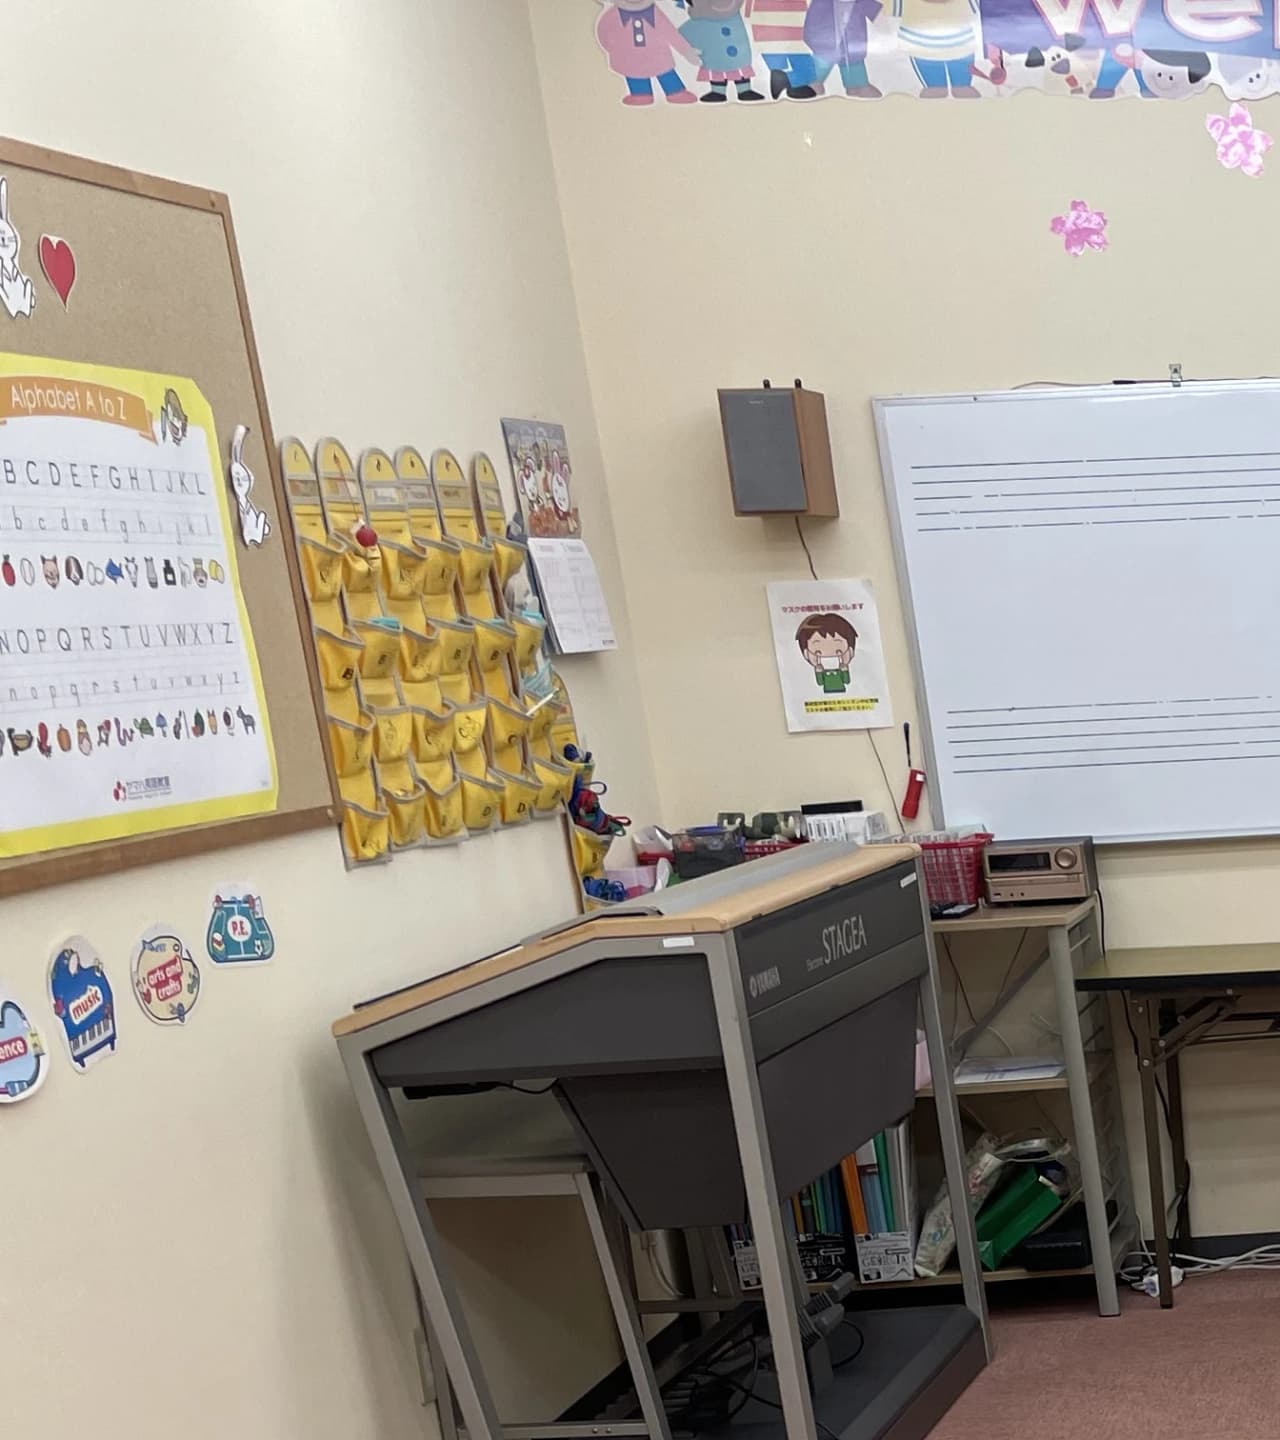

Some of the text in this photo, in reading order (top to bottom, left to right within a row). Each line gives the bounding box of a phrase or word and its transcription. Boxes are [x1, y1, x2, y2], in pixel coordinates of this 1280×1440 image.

[10, 384, 127, 420] Alphabet A to Z
[231, 920, 249, 937] P.E.
[822, 915, 868, 964] STAGEA
[149, 967, 165, 986] arts
[158, 976, 181, 999] crafts
[72, 989, 102, 1020] music
